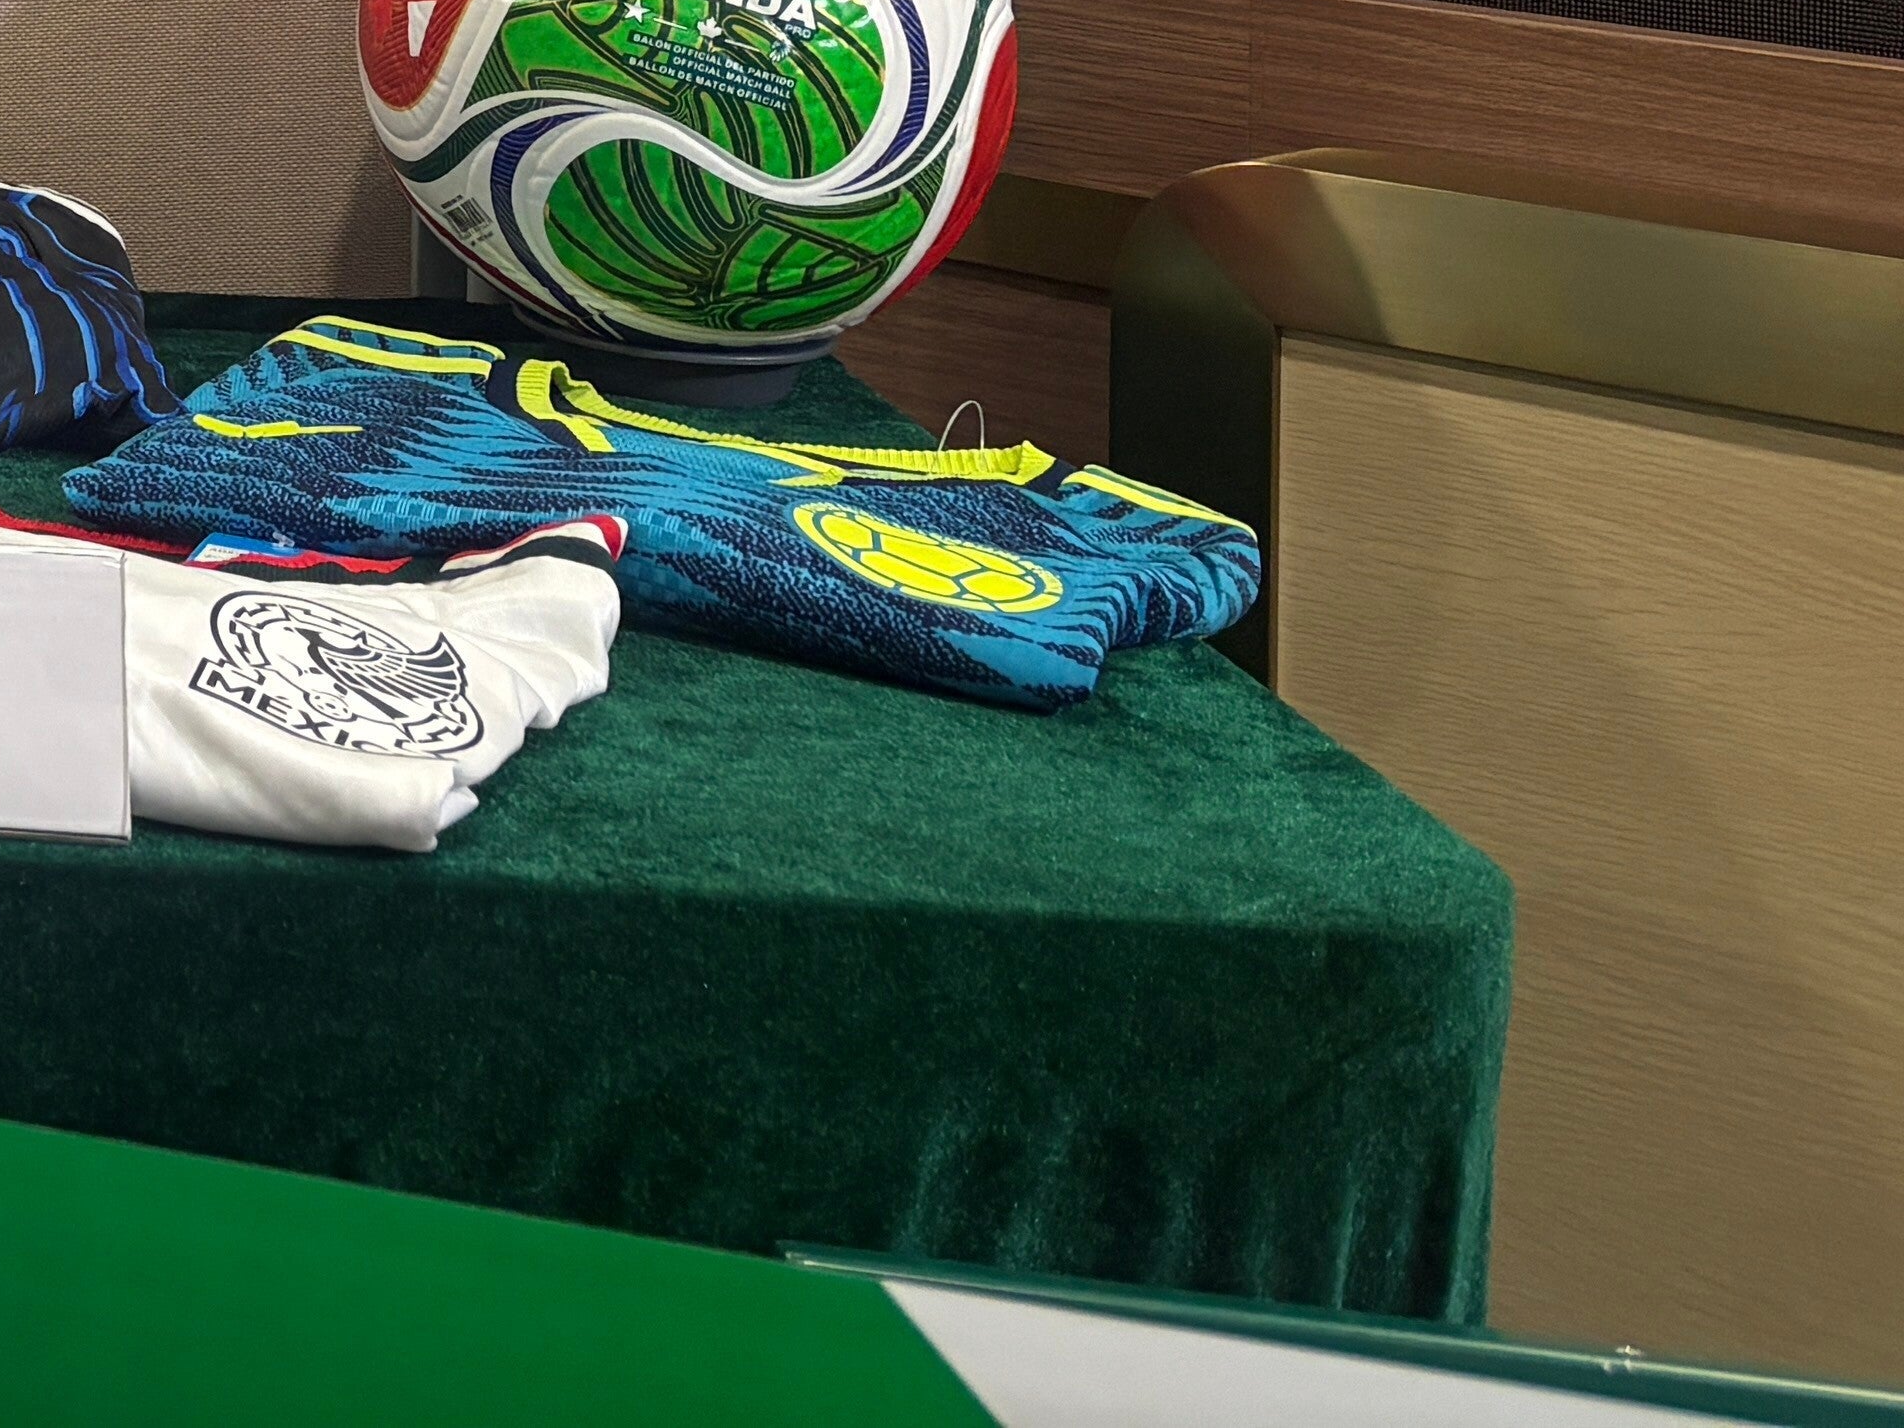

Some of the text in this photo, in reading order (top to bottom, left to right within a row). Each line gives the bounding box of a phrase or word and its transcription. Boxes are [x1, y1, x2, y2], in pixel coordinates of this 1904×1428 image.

[784, 23, 812, 39] PRO
[628, 56, 788, 112] BALLON DE MATCH OFFICIAL
[672, 56, 792, 100] OFFICIAL MATCH BALL
[747, 66, 795, 89] PARTIDO
